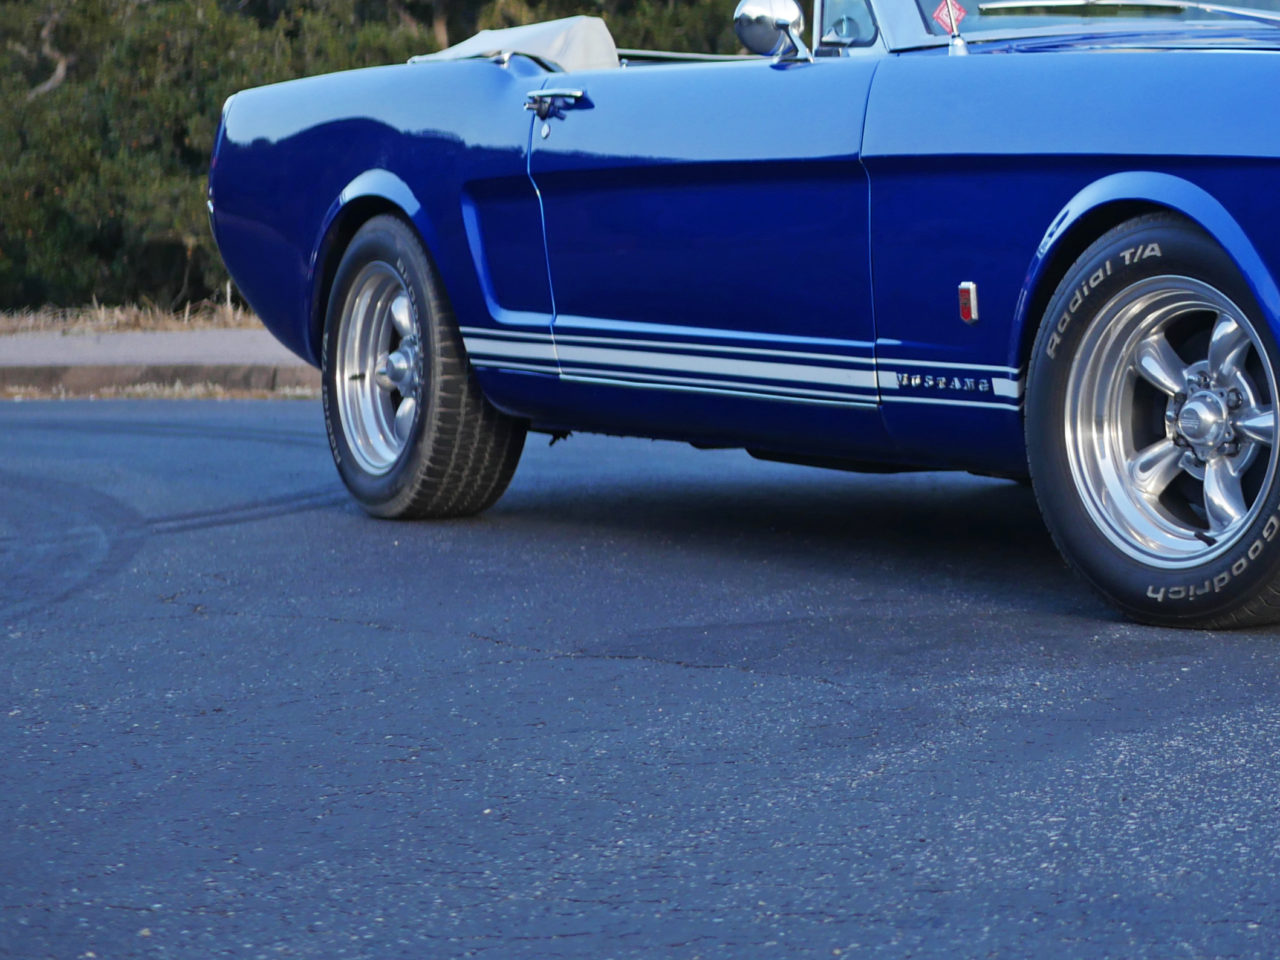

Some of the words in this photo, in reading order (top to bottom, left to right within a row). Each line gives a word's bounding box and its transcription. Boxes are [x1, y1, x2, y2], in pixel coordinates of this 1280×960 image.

[1045, 259, 1112, 360] Radial
[1119, 242, 1163, 266] T/A
[897, 372, 990, 392] MUSTANG
